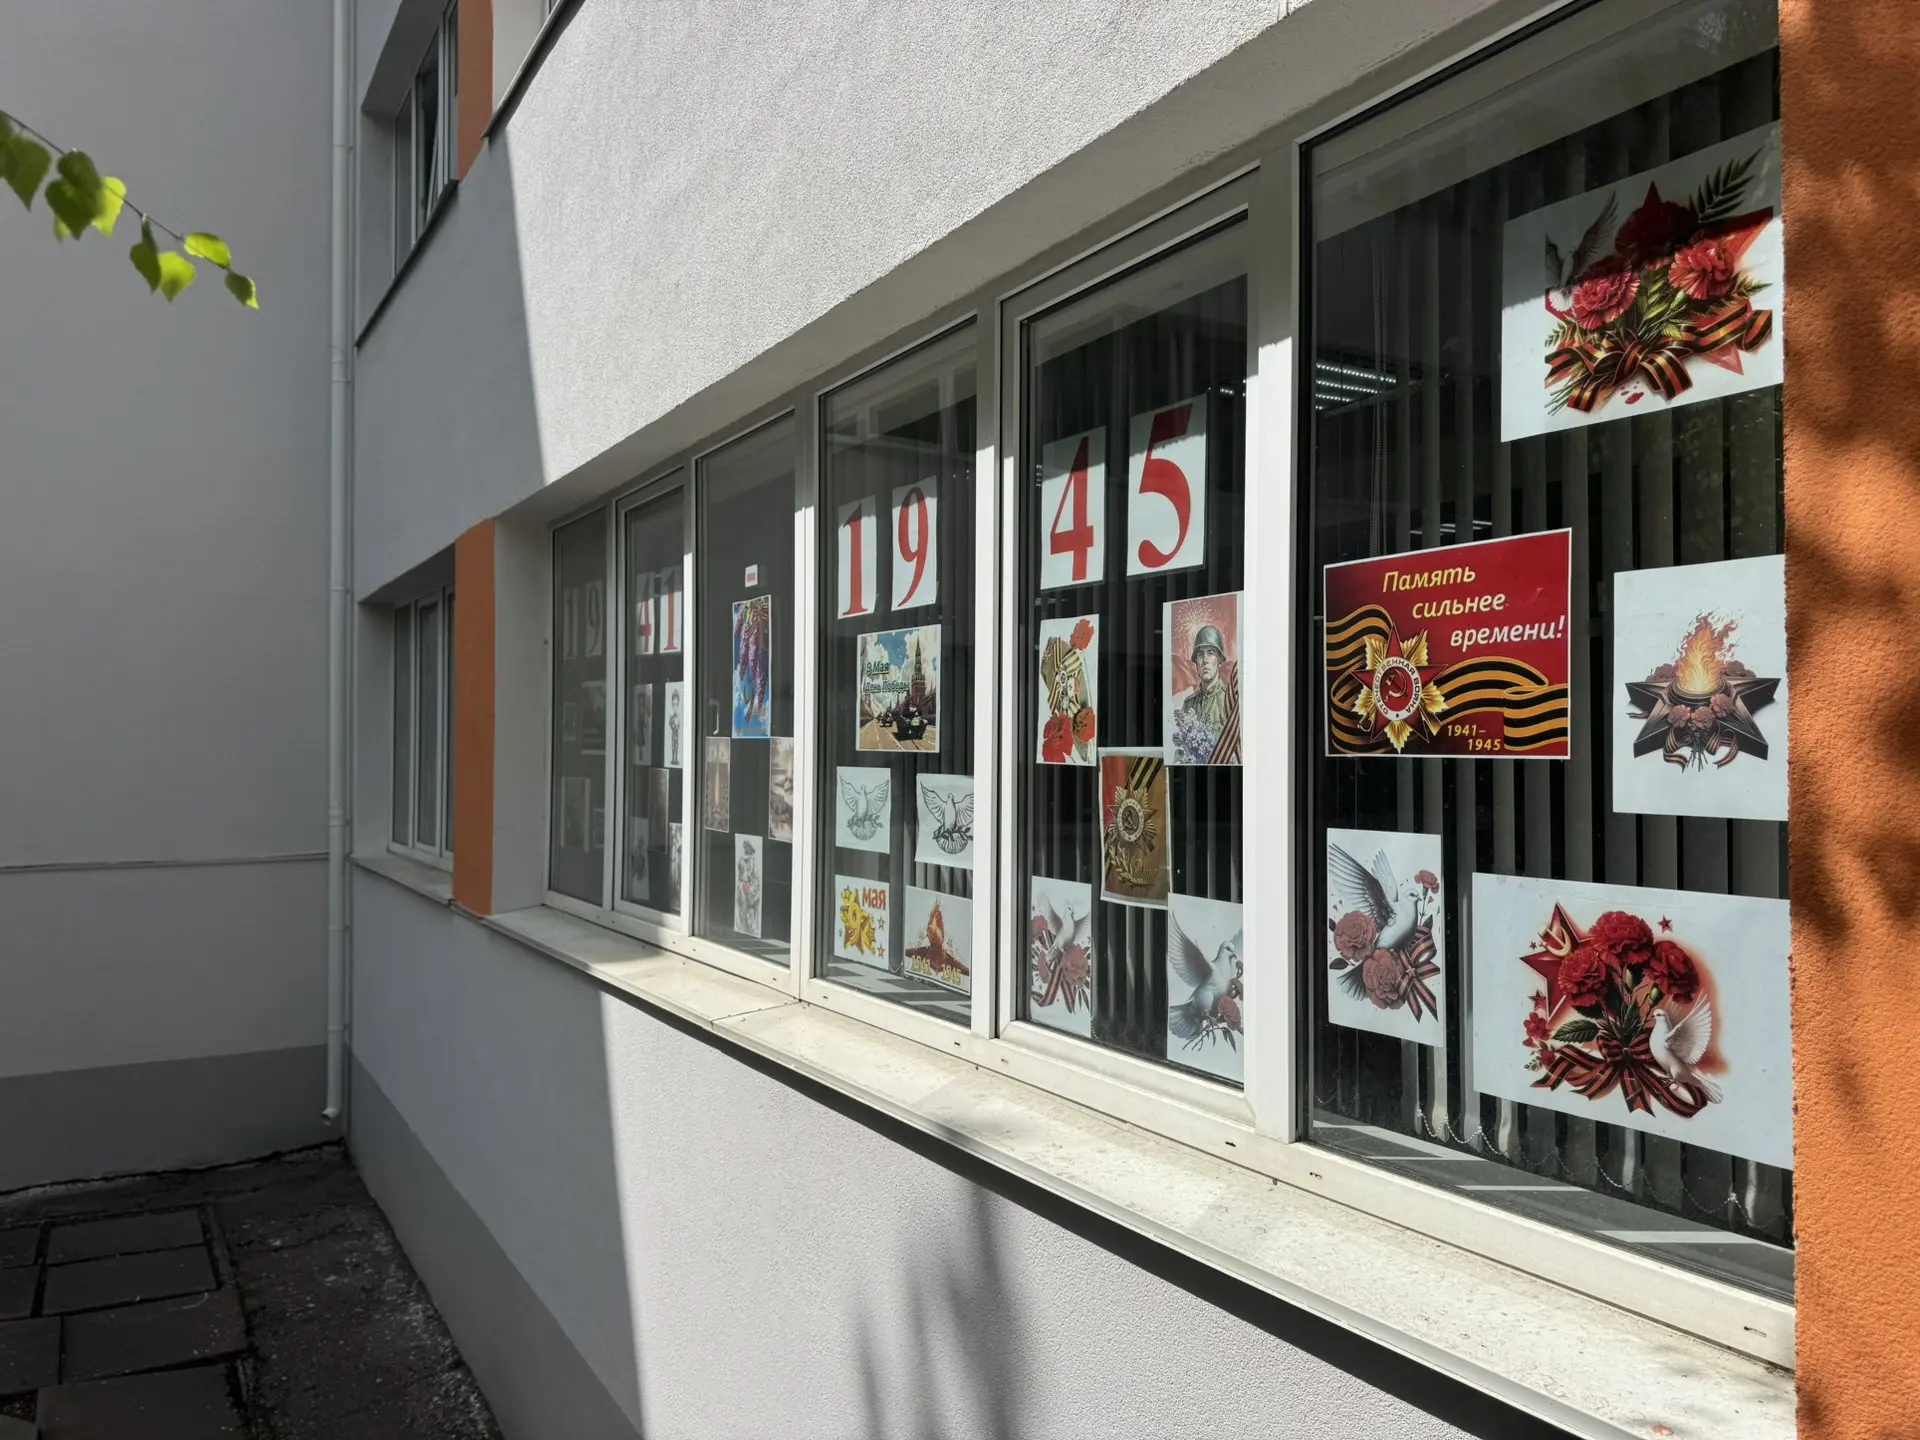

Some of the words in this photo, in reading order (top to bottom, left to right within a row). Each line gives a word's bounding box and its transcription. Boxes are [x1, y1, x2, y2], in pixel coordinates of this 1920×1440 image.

[1382, 565, 1476, 593] Память
[1412, 592, 1506, 620] сильнее
[1450, 615, 1566, 652] времени!
[1467, 738, 1501, 751] 1945
